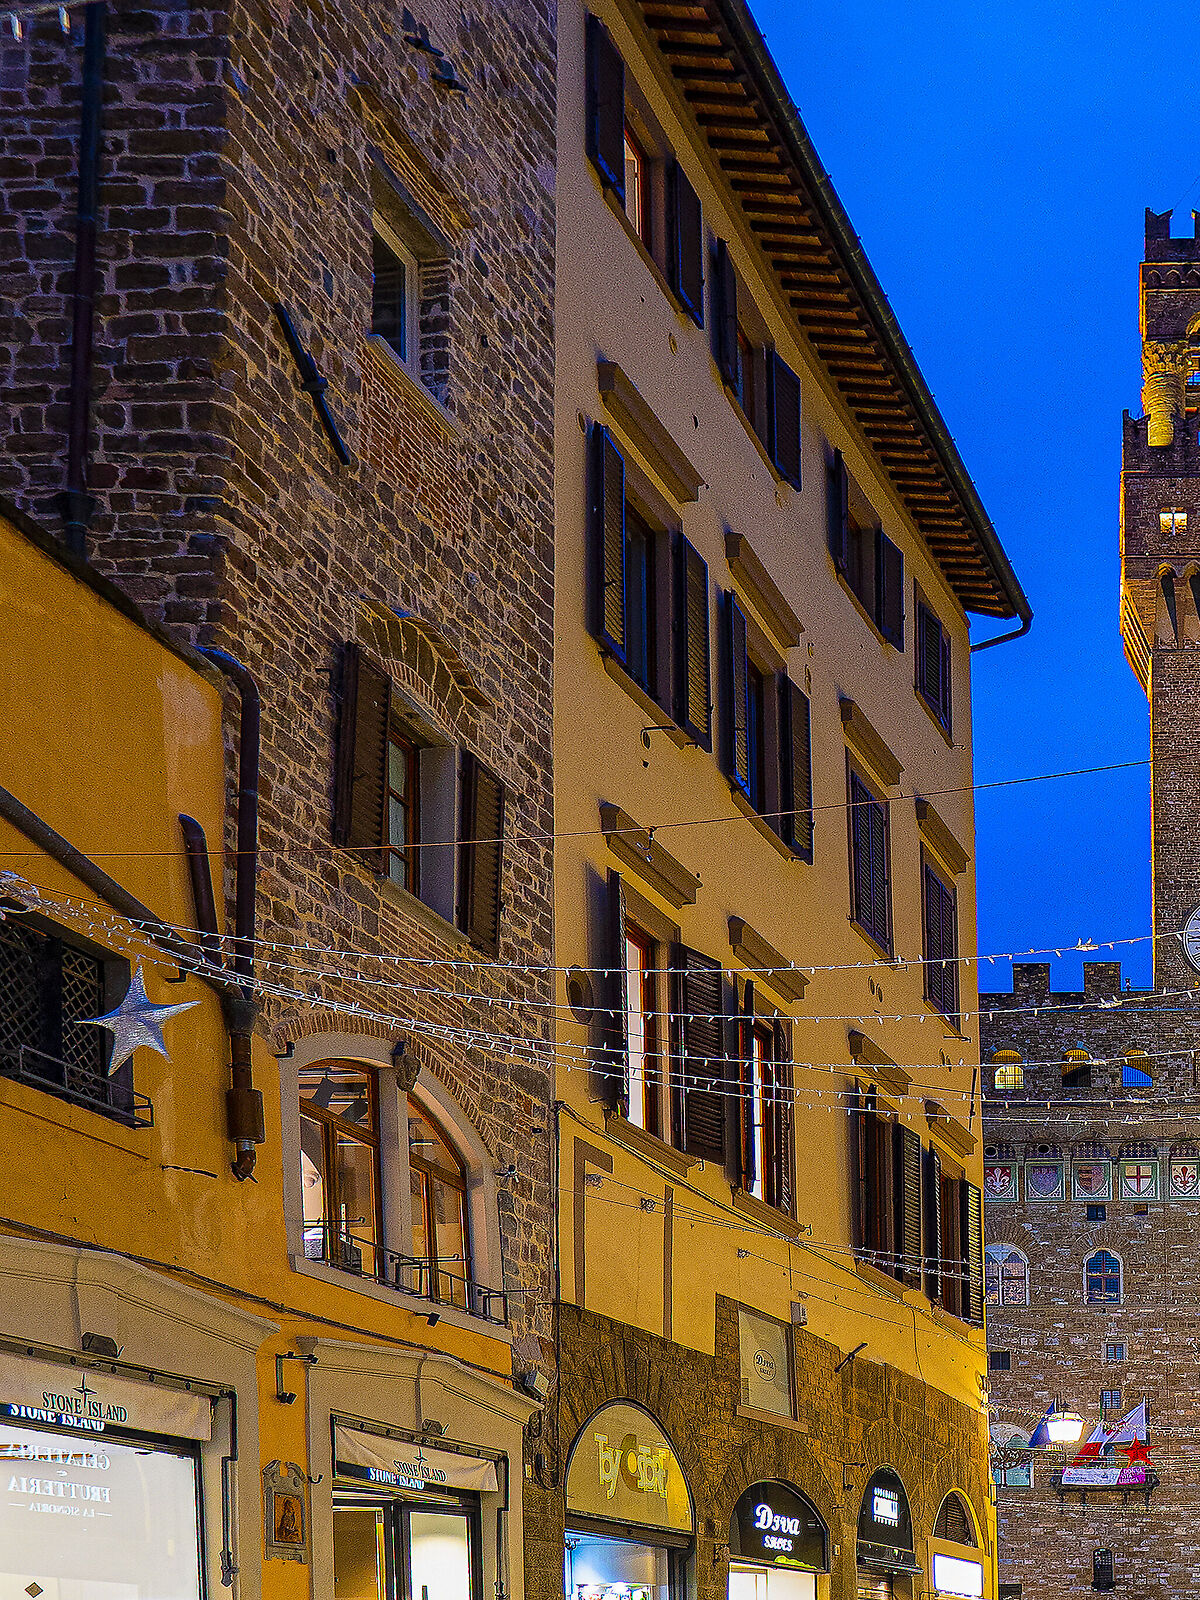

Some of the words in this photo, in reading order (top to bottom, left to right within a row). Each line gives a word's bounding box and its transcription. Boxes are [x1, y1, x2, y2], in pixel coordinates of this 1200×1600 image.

[9, 1403, 57, 1423] STONE
[61, 1412, 105, 1432] ISLAND
[42, 1391, 83, 1415] STONE
[88, 1400, 128, 1423] ISLAND
[368, 1467, 397, 1485] STONE
[398, 1474, 425, 1490] ISLAND
[393, 1460, 419, 1478] STONE
[421, 1466, 447, 1482] ISLAND
[754, 1503, 800, 1536] Diva
